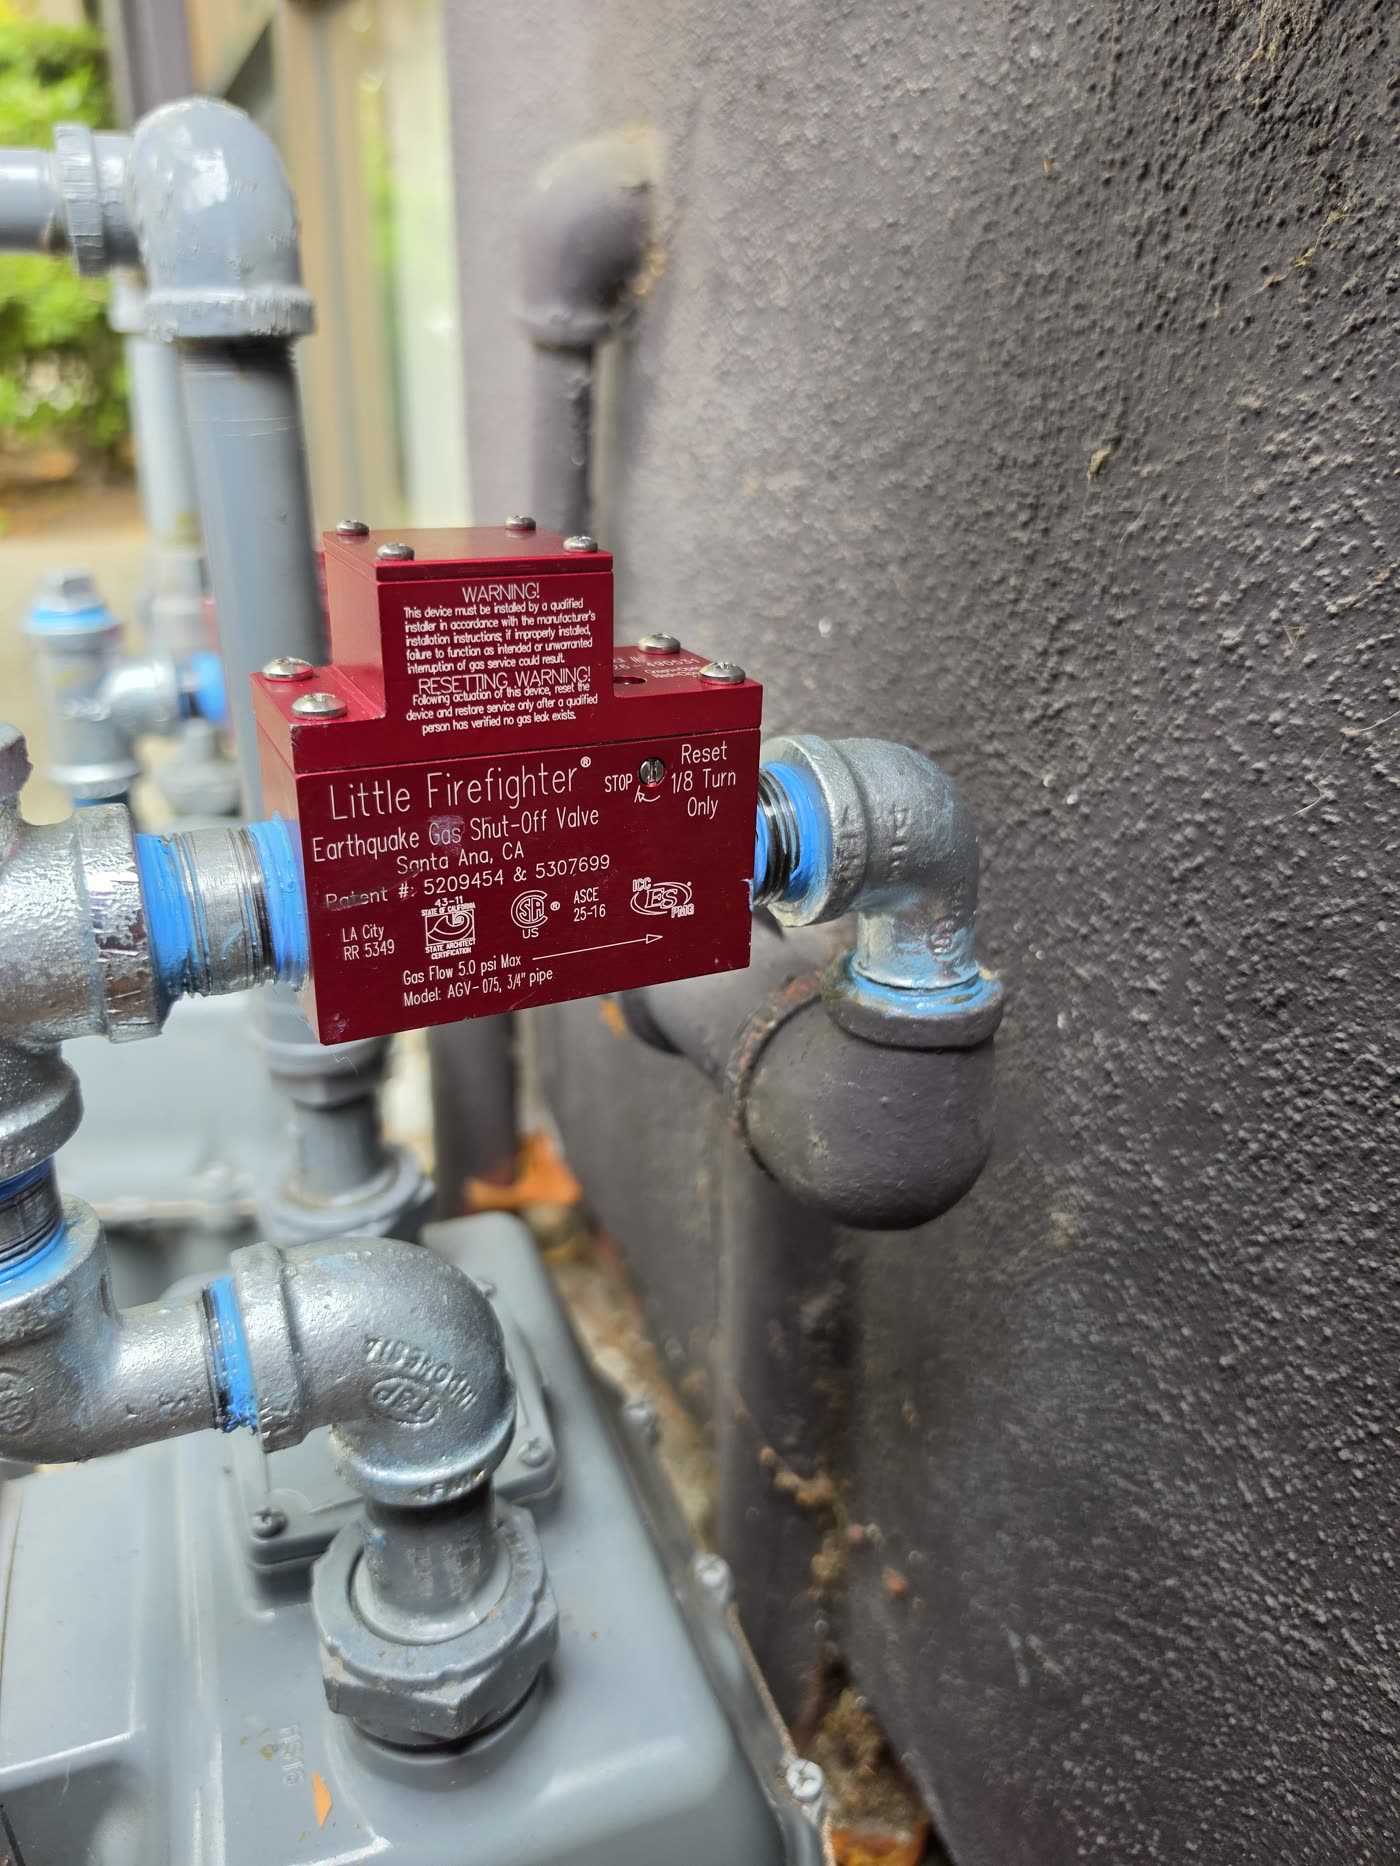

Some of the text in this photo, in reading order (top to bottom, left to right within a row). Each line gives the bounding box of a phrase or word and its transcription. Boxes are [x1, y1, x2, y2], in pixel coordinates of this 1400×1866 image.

[462, 582, 540, 603] WARNING!
[404, 597, 584, 619] This device must be installed by a qualified
[405, 611, 596, 633] installer in accordance with the manufacturer's
[406, 625, 591, 647] installation instructions; if improperly installed,
[406, 637, 593, 661] failure to function as intended or unwarranted
[407, 653, 566, 675] interruption of gas service could result.
[419, 666, 591, 695] RESETTING WARNING!
[413, 680, 590, 706] Following actuation of this device, reset the
[406, 693, 599, 721] device and restore service only after a qualified
[422, 709, 576, 736] person has verified no gas leak exists.
[681, 740, 728, 765] Reset
[604, 773, 633, 793] STOP
[671, 768, 737, 794] 1/8 Turn
[330, 779, 411, 820] Little
[687, 796, 719, 820] Only
[312, 805, 599, 862] Earthquake Gas Shut-Off Valve
[397, 840, 525, 875] Santa Ana, CA
[324, 886, 389, 910] Patent
[423, 869, 504, 895] 5209454
[513, 866, 527, 882] &
[535, 854, 610, 879] 5307699
[632, 876, 652, 893] ICC
[434, 895, 464, 907] 43-11
[573, 886, 599, 904] ASCE
[644, 887, 679, 910] ES
[421, 907, 438, 917] STATE
[438, 906, 446, 914] OF
[573, 903, 606, 922] 25-16
[342, 923, 385, 943] LA City
[522, 927, 539, 939] US
[343, 938, 395, 961] RR 5349
[425, 944, 445, 954] STATE
[403, 953, 522, 986] Gas Flow 5.0 psi Max
[403, 989, 442, 1007] Model:
[529, 967, 553, 987] pipe
